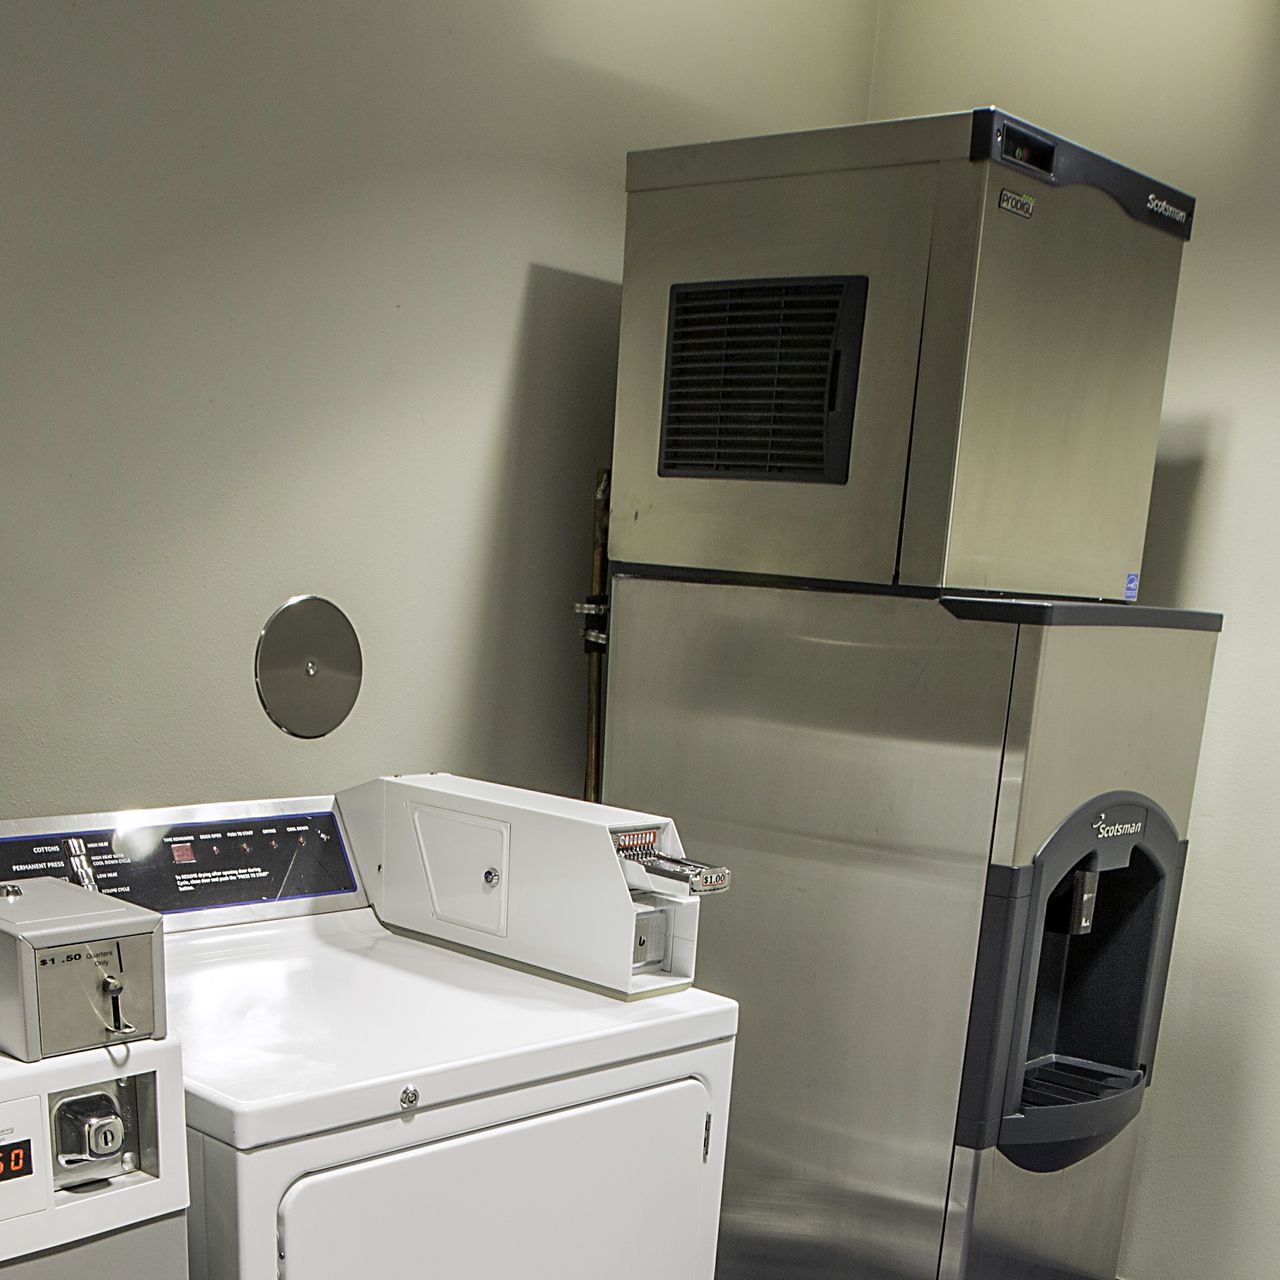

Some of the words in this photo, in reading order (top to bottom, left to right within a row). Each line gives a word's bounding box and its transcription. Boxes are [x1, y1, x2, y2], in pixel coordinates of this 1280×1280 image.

[1146, 193, 1186, 223] Scotsman
[1097, 822, 1142, 838] Scotsman
[32, 845, 60, 854] COTTONS
[12, 862, 47, 872] PERMANENT
[47, 860, 65, 868] PRESS
[703, 874, 726, 884] $1.00
[86, 951, 113, 960] Quarters
